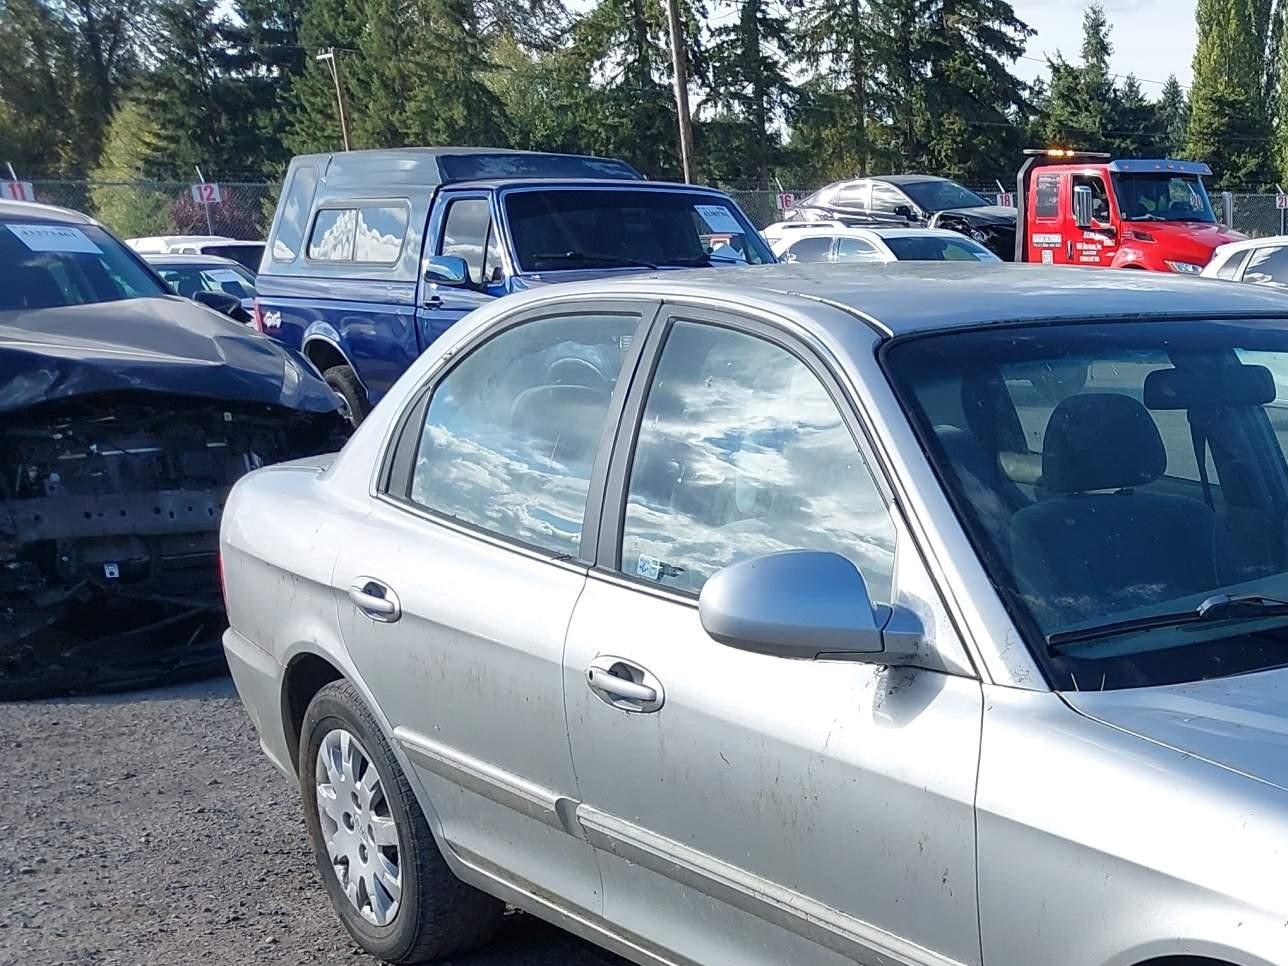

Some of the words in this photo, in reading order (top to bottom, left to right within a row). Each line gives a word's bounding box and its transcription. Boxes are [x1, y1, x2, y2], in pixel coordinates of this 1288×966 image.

[195, 185, 216, 200] 12
[779, 194, 792, 208] 16
[1000, 193, 1011, 207] 18
[1278, 195, 1288, 208] 21
